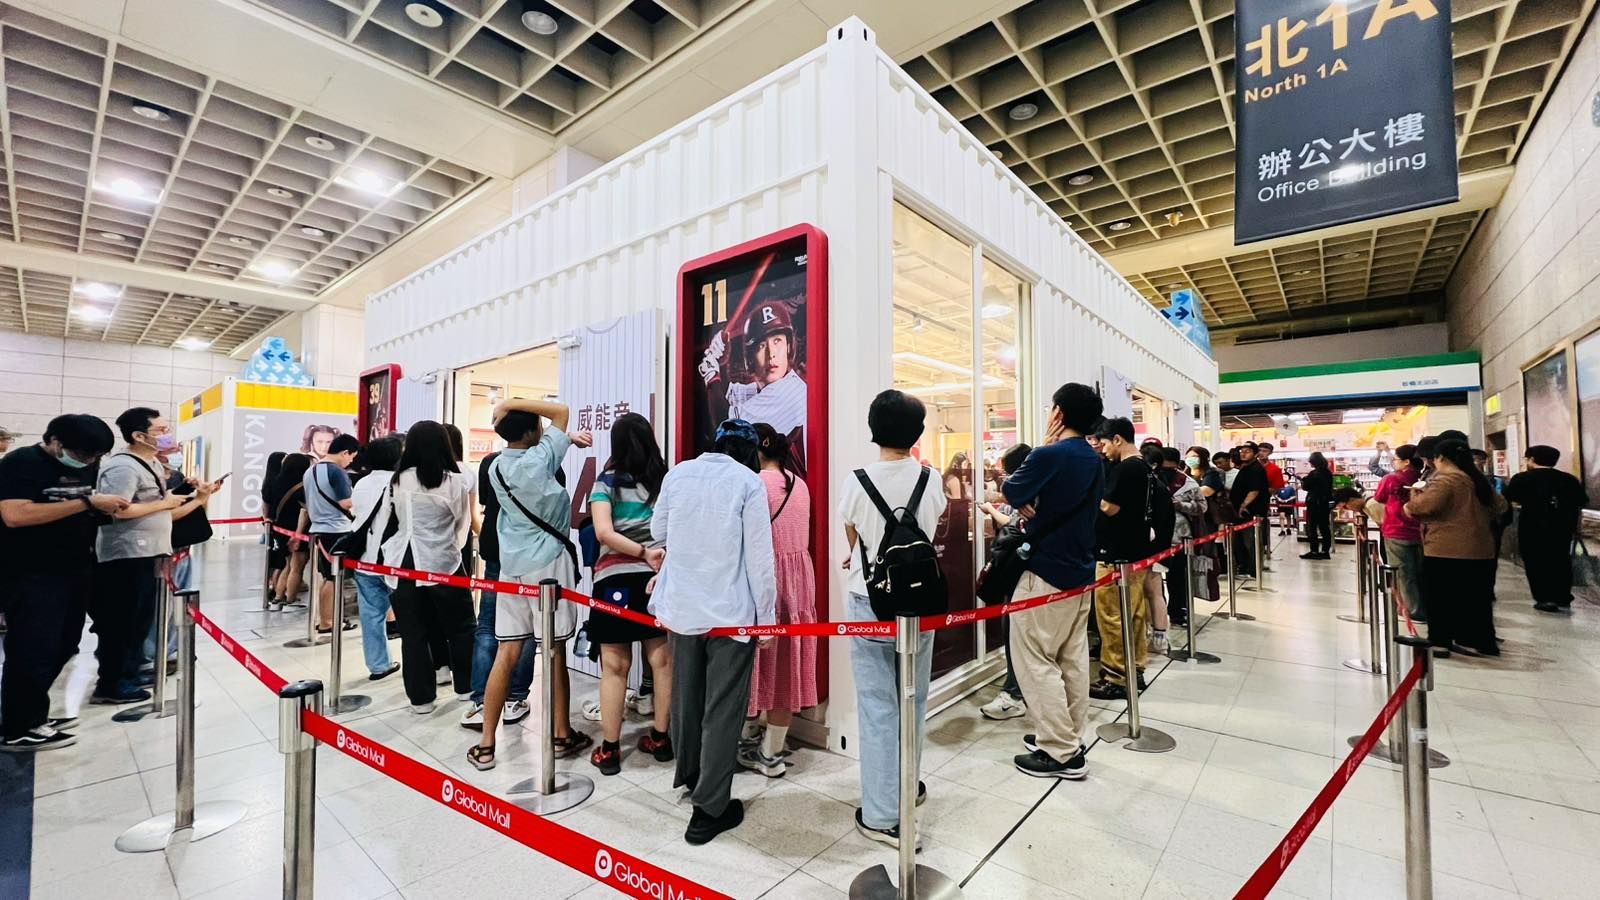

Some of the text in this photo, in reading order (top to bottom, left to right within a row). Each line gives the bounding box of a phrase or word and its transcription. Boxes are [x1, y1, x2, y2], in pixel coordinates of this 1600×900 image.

[1245, 58, 1348, 103] North 1A
[1258, 112, 1426, 181] 辦公大樓
[1257, 152, 1427, 202] Office Bilding
[701, 279, 727, 326] 11
[762, 306, 777, 324] R
[369, 383, 380, 405] 39
[747, 627, 770, 635] Global
[847, 625, 891, 633] Global Mall
[345, 736, 385, 767] Global Mall
[454, 788, 510, 829] Global Mall
[614, 862, 664, 900] Global
